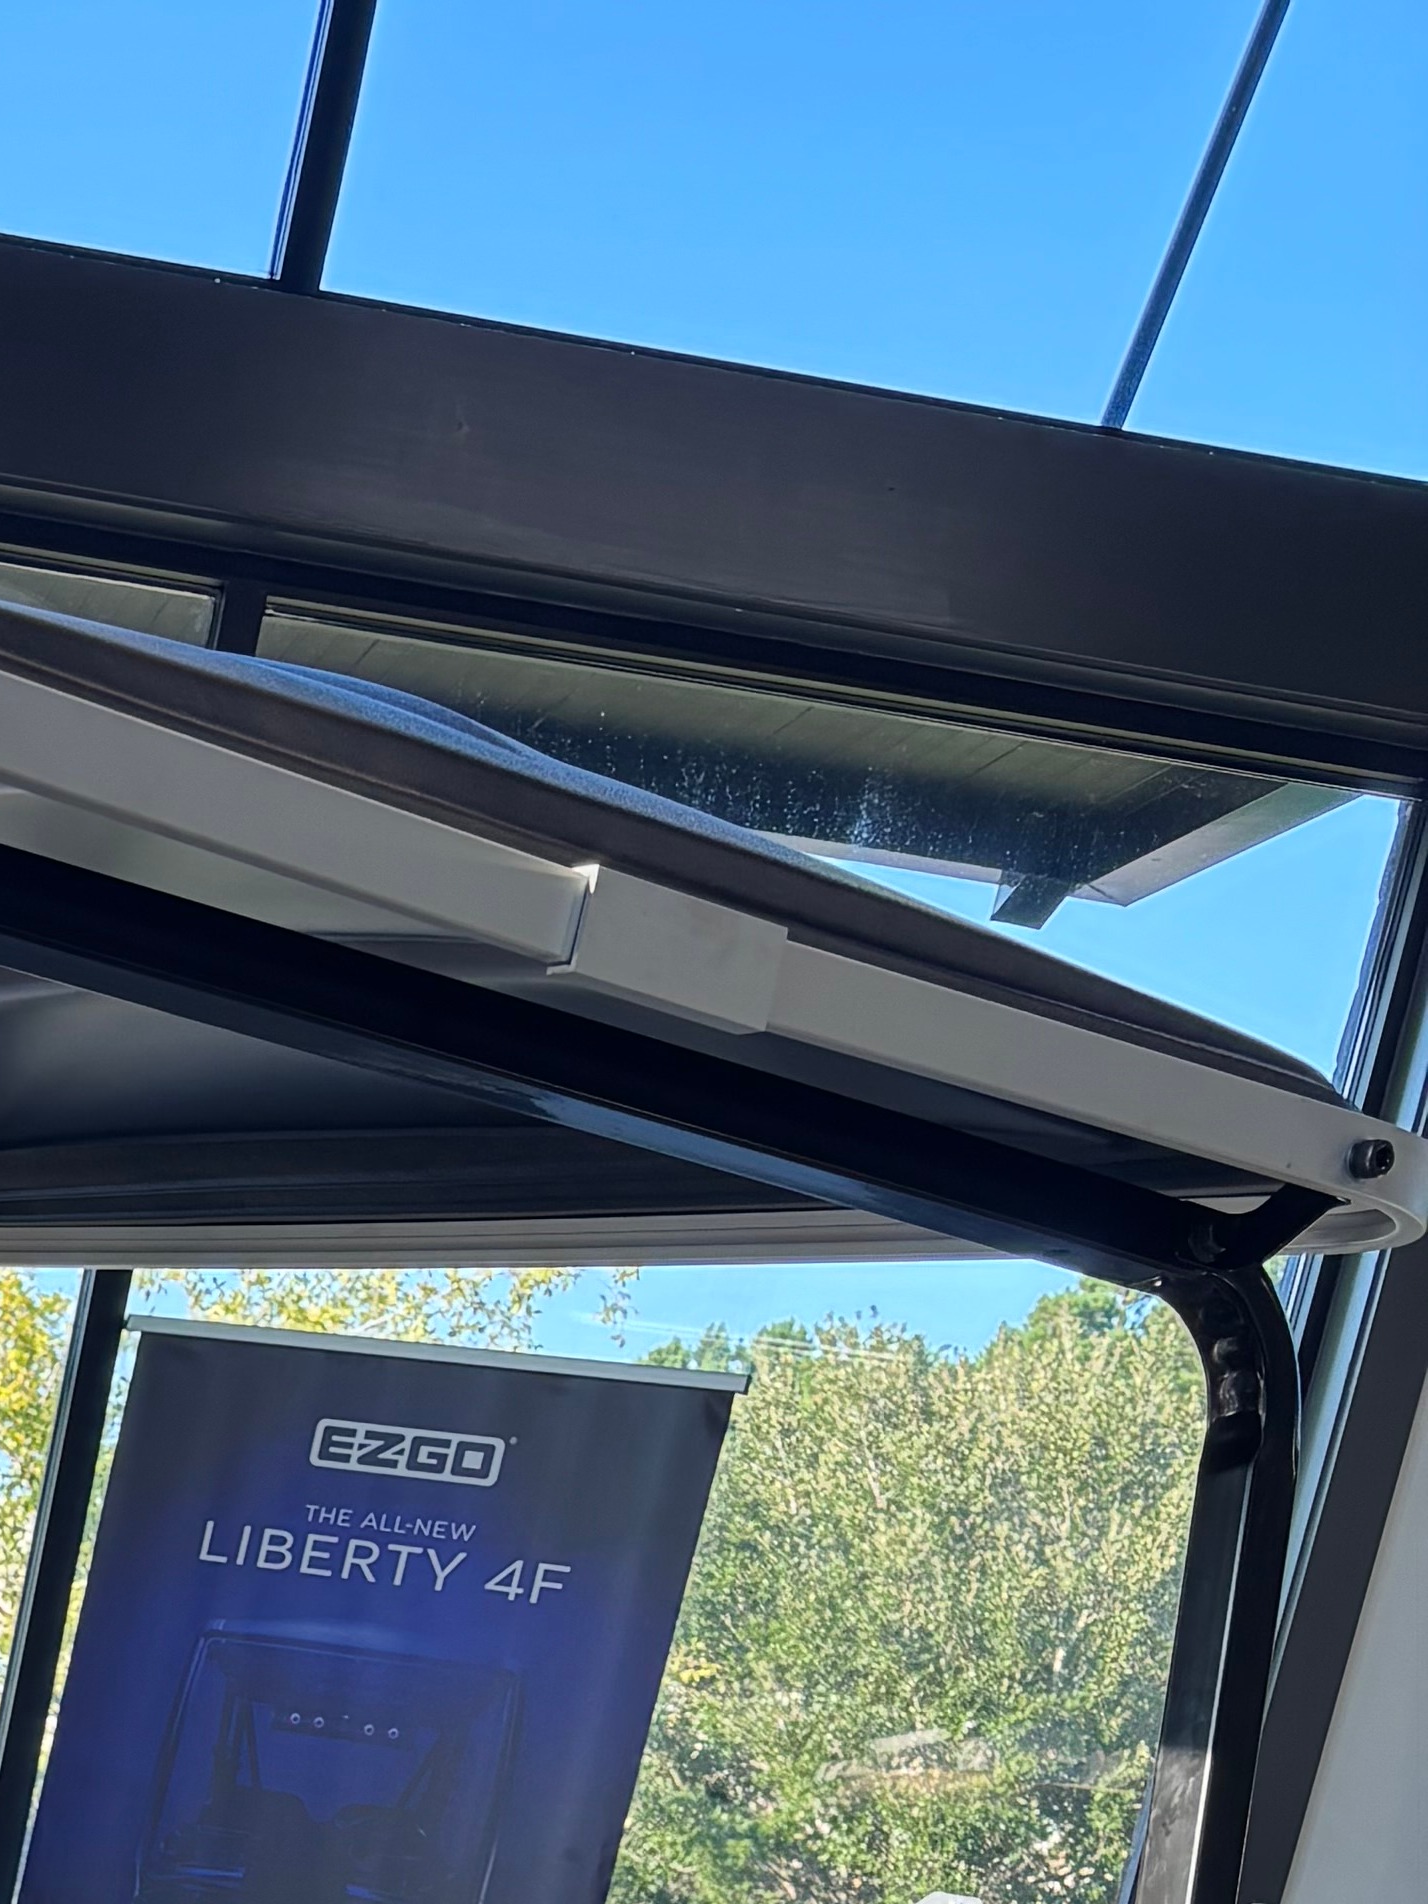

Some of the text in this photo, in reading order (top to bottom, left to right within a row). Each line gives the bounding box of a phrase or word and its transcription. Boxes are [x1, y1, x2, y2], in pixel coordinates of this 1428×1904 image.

[317, 1425, 498, 1482] EZGO
[305, 1503, 476, 1542] THE ALL-NEW
[198, 1520, 572, 1604] LIBERTY 4F
